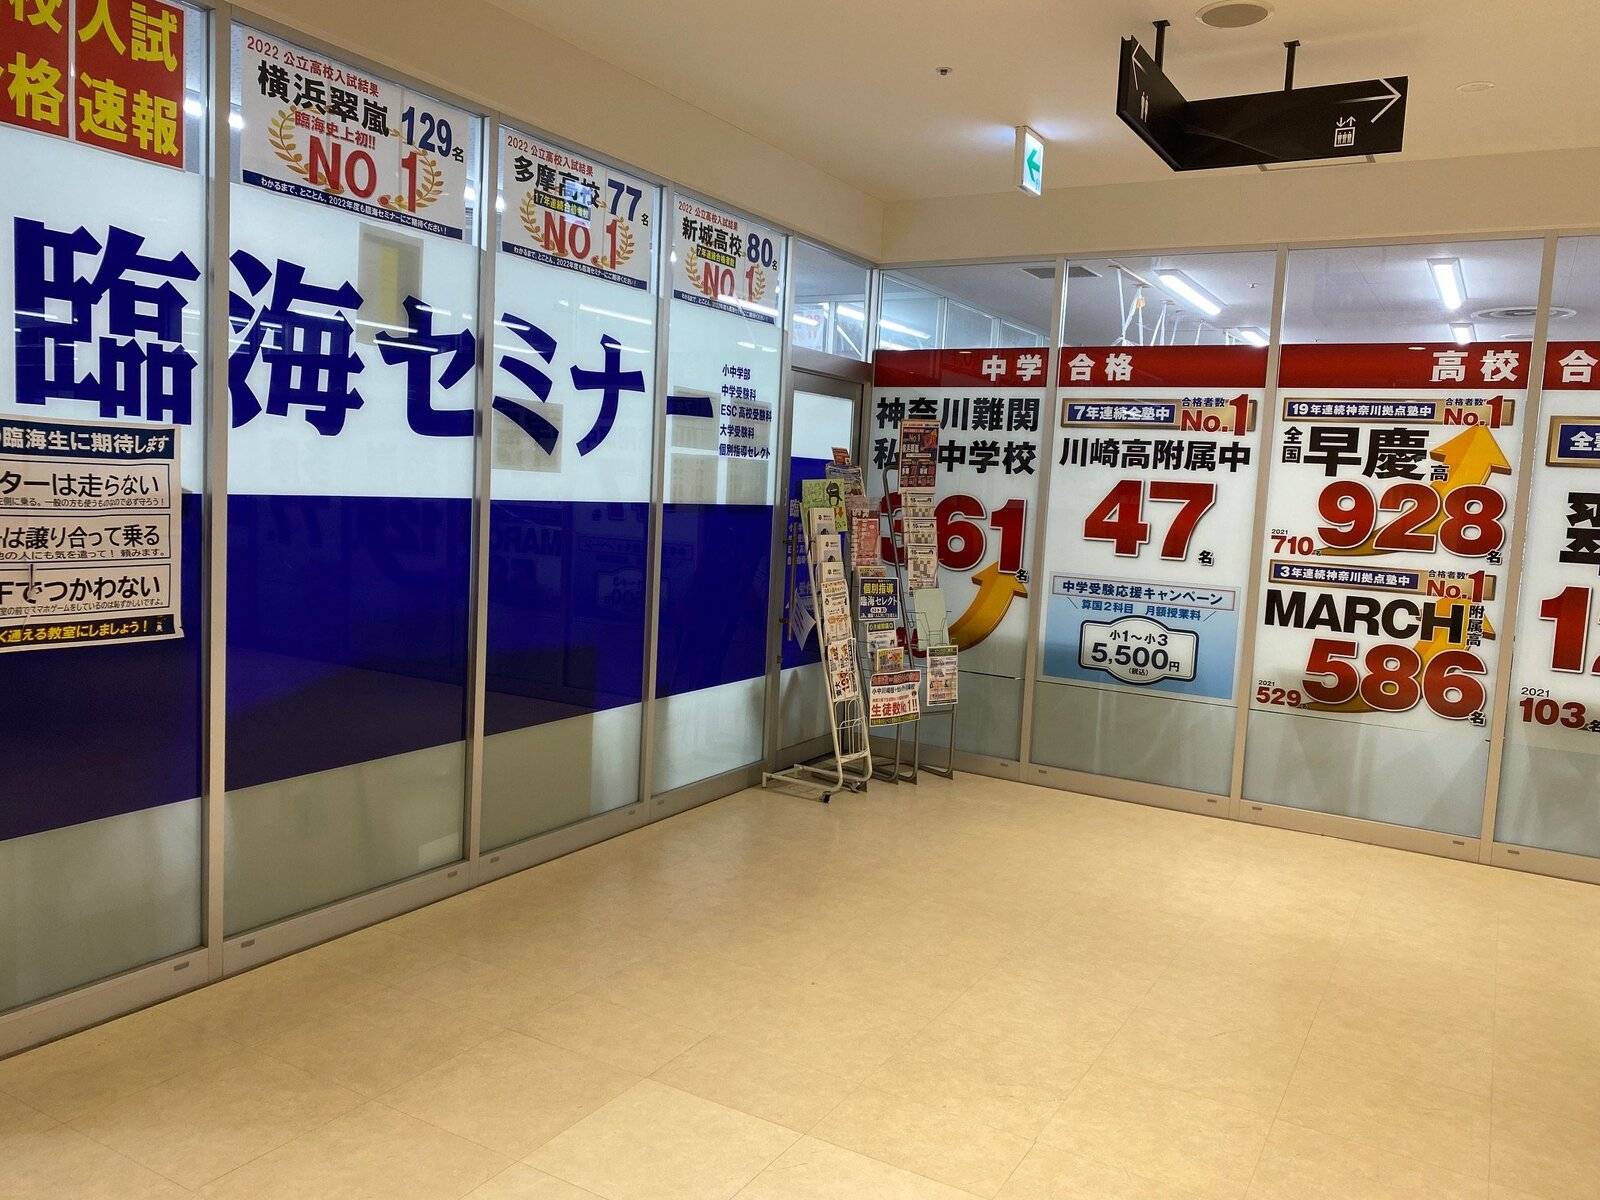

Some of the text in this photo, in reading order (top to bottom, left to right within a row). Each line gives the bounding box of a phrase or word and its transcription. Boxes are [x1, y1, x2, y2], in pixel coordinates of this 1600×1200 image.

[246, 36, 380, 98] 2022 公立高校入試結果
[0, 51, 178, 157] 格速報
[257, 59, 390, 137] 横浜翠嵐
[401, 105, 452, 157] 129
[507, 136, 594, 177] 2022 公立高校入試結果
[607, 178, 642, 221] 77
[679, 201, 693, 215] 2022
[682, 216, 742, 258] 新城高校
[747, 233, 773, 268] 80
[722, 364, 751, 381] 小中学部
[982, 353, 1133, 381] 中学 合格
[1429, 350, 1520, 382] 高校
[1558, 350, 1599, 382] 合
[721, 384, 757, 401] 中学受験科
[1182, 397, 1225, 408] 合格者数
[721, 404, 772, 423] ESC 高校受験科
[1074, 406, 1170, 422] 7年連続全塾中
[1180, 393, 1249, 436] No.1
[1292, 403, 1432, 418] 19年連続神奈川拠点塾中
[1443, 395, 1504, 429] No.1
[0, 427, 169, 454] 臨海生に期待します
[720, 424, 755, 440] 大学受験科
[1282, 426, 1303, 463] 全国
[719, 443, 771, 460] 個別指導セレクト
[873, 438, 1037, 475] 私中学校
[1059, 437, 1251, 472] 川崎高附属中
[1303, 426, 1430, 480] 早慶
[0, 471, 160, 498] ターは走らない
[1430, 465, 1449, 482] 高
[0, 525, 160, 549] は譲り合って乗る
[1083, 480, 1217, 566] 47 名
[1317, 481, 1506, 557] 928
[1487, 550, 1502, 565] 名
[1270, 535, 1314, 556] 710
[1063, 580, 1223, 605] 中学受験応援キャンペーン
[1280, 567, 1410, 586] 3年連続神奈川拠点塾中
[1426, 570, 1485, 603] No.1
[1145, 605, 1201, 621] 月額授業料
[1264, 589, 1464, 644] MARCH
[1467, 605, 1485, 647] 附属高
[1256, 687, 1301, 708] 529
[1302, 638, 1486, 726] 586 名
[1521, 687, 1550, 698] 2021
[1520, 697, 1587, 729] 103
